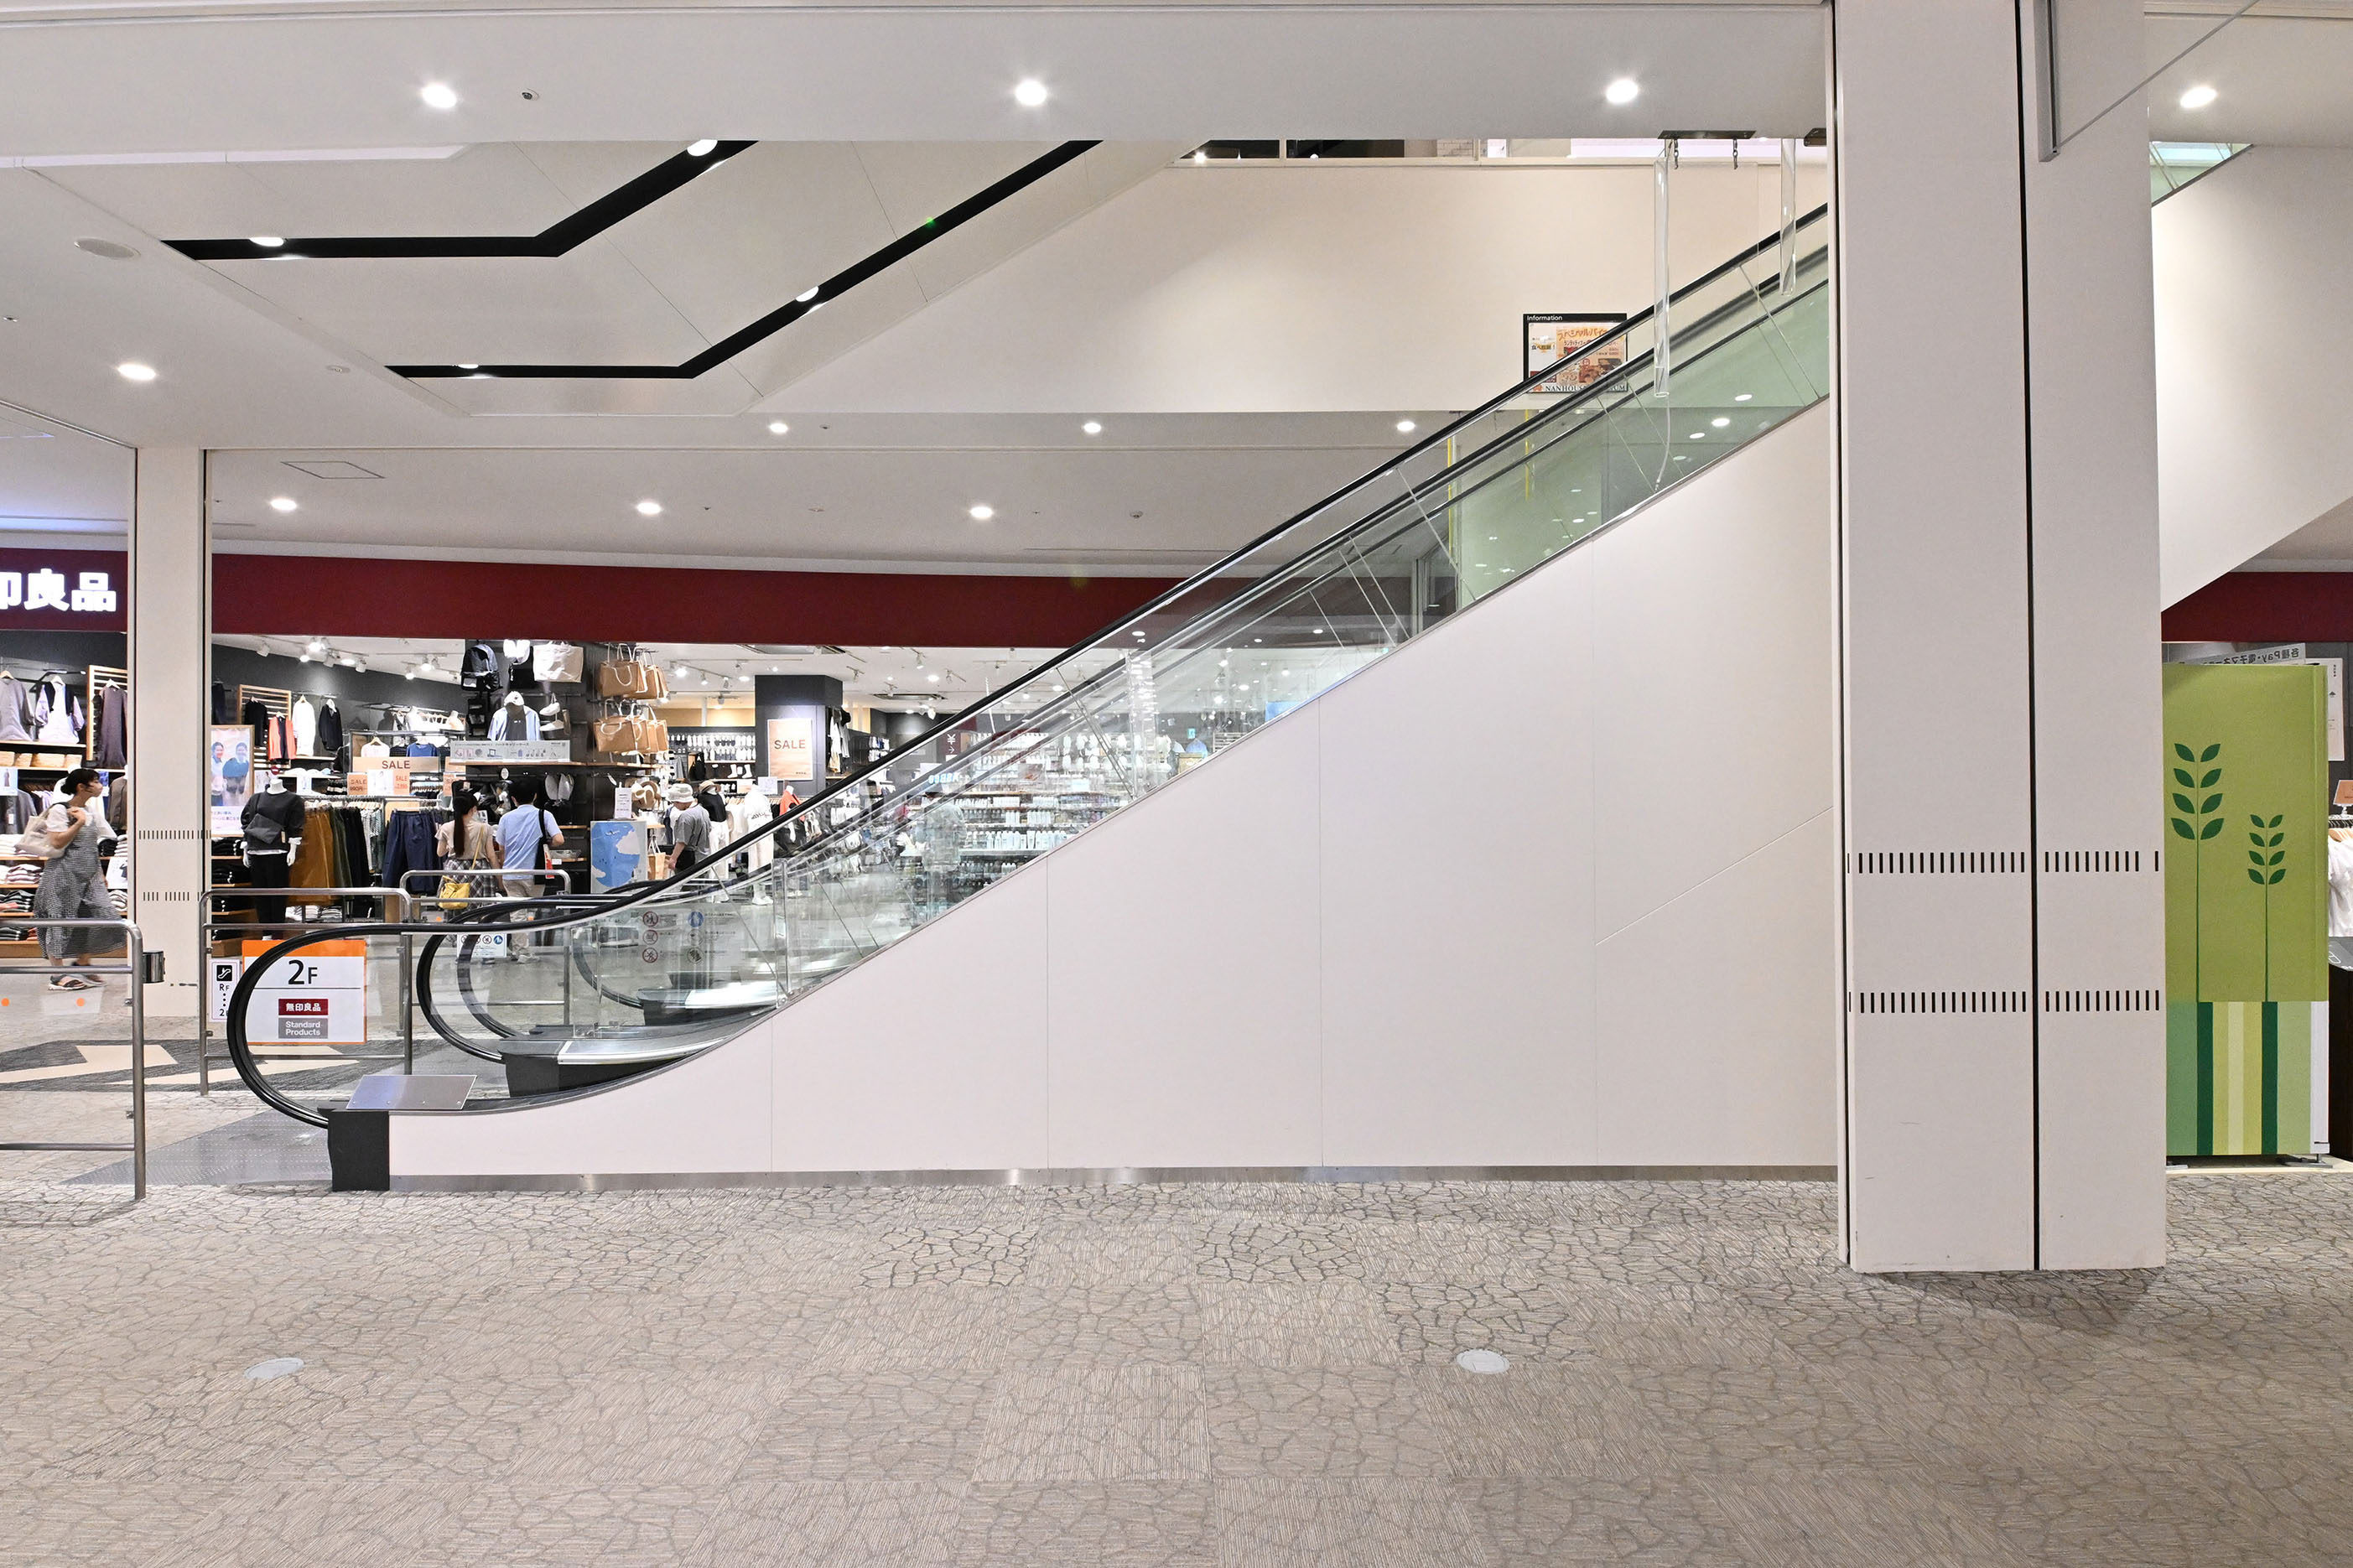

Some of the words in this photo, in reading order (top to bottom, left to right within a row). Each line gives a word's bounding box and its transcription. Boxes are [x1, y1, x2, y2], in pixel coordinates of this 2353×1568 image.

[774, 739, 807, 750] SALE
[382, 760, 411, 769] SALE
[288, 959, 318, 985] 2F
[219, 983, 230, 991] RF
[286, 1002, 321, 1012] 無印良品
[285, 1028, 321, 1036] Products
